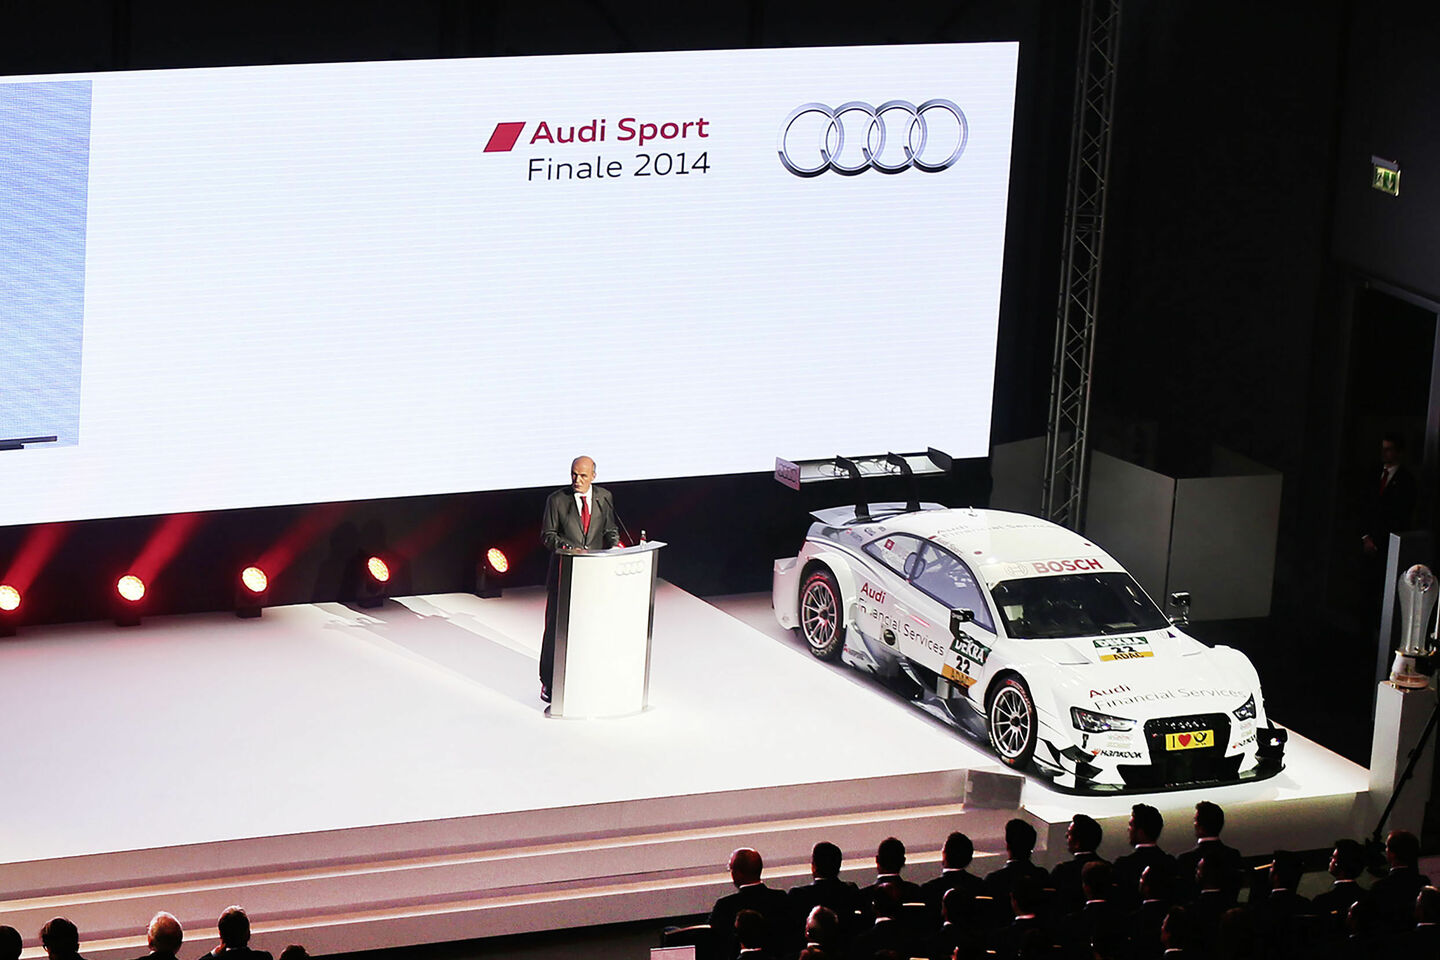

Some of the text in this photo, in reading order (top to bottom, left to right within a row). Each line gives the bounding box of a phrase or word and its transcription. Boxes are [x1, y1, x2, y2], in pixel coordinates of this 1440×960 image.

[530, 117, 710, 146] Audi Sport
[528, 152, 710, 181] Finale 2014
[1032, 559, 1103, 574] BOSCH
[861, 582, 886, 604] Audi
[903, 623, 945, 656] Services
[956, 655, 970, 675] 22
[1090, 684, 1131, 698] Audi
[1094, 690, 1174, 710] Financial
